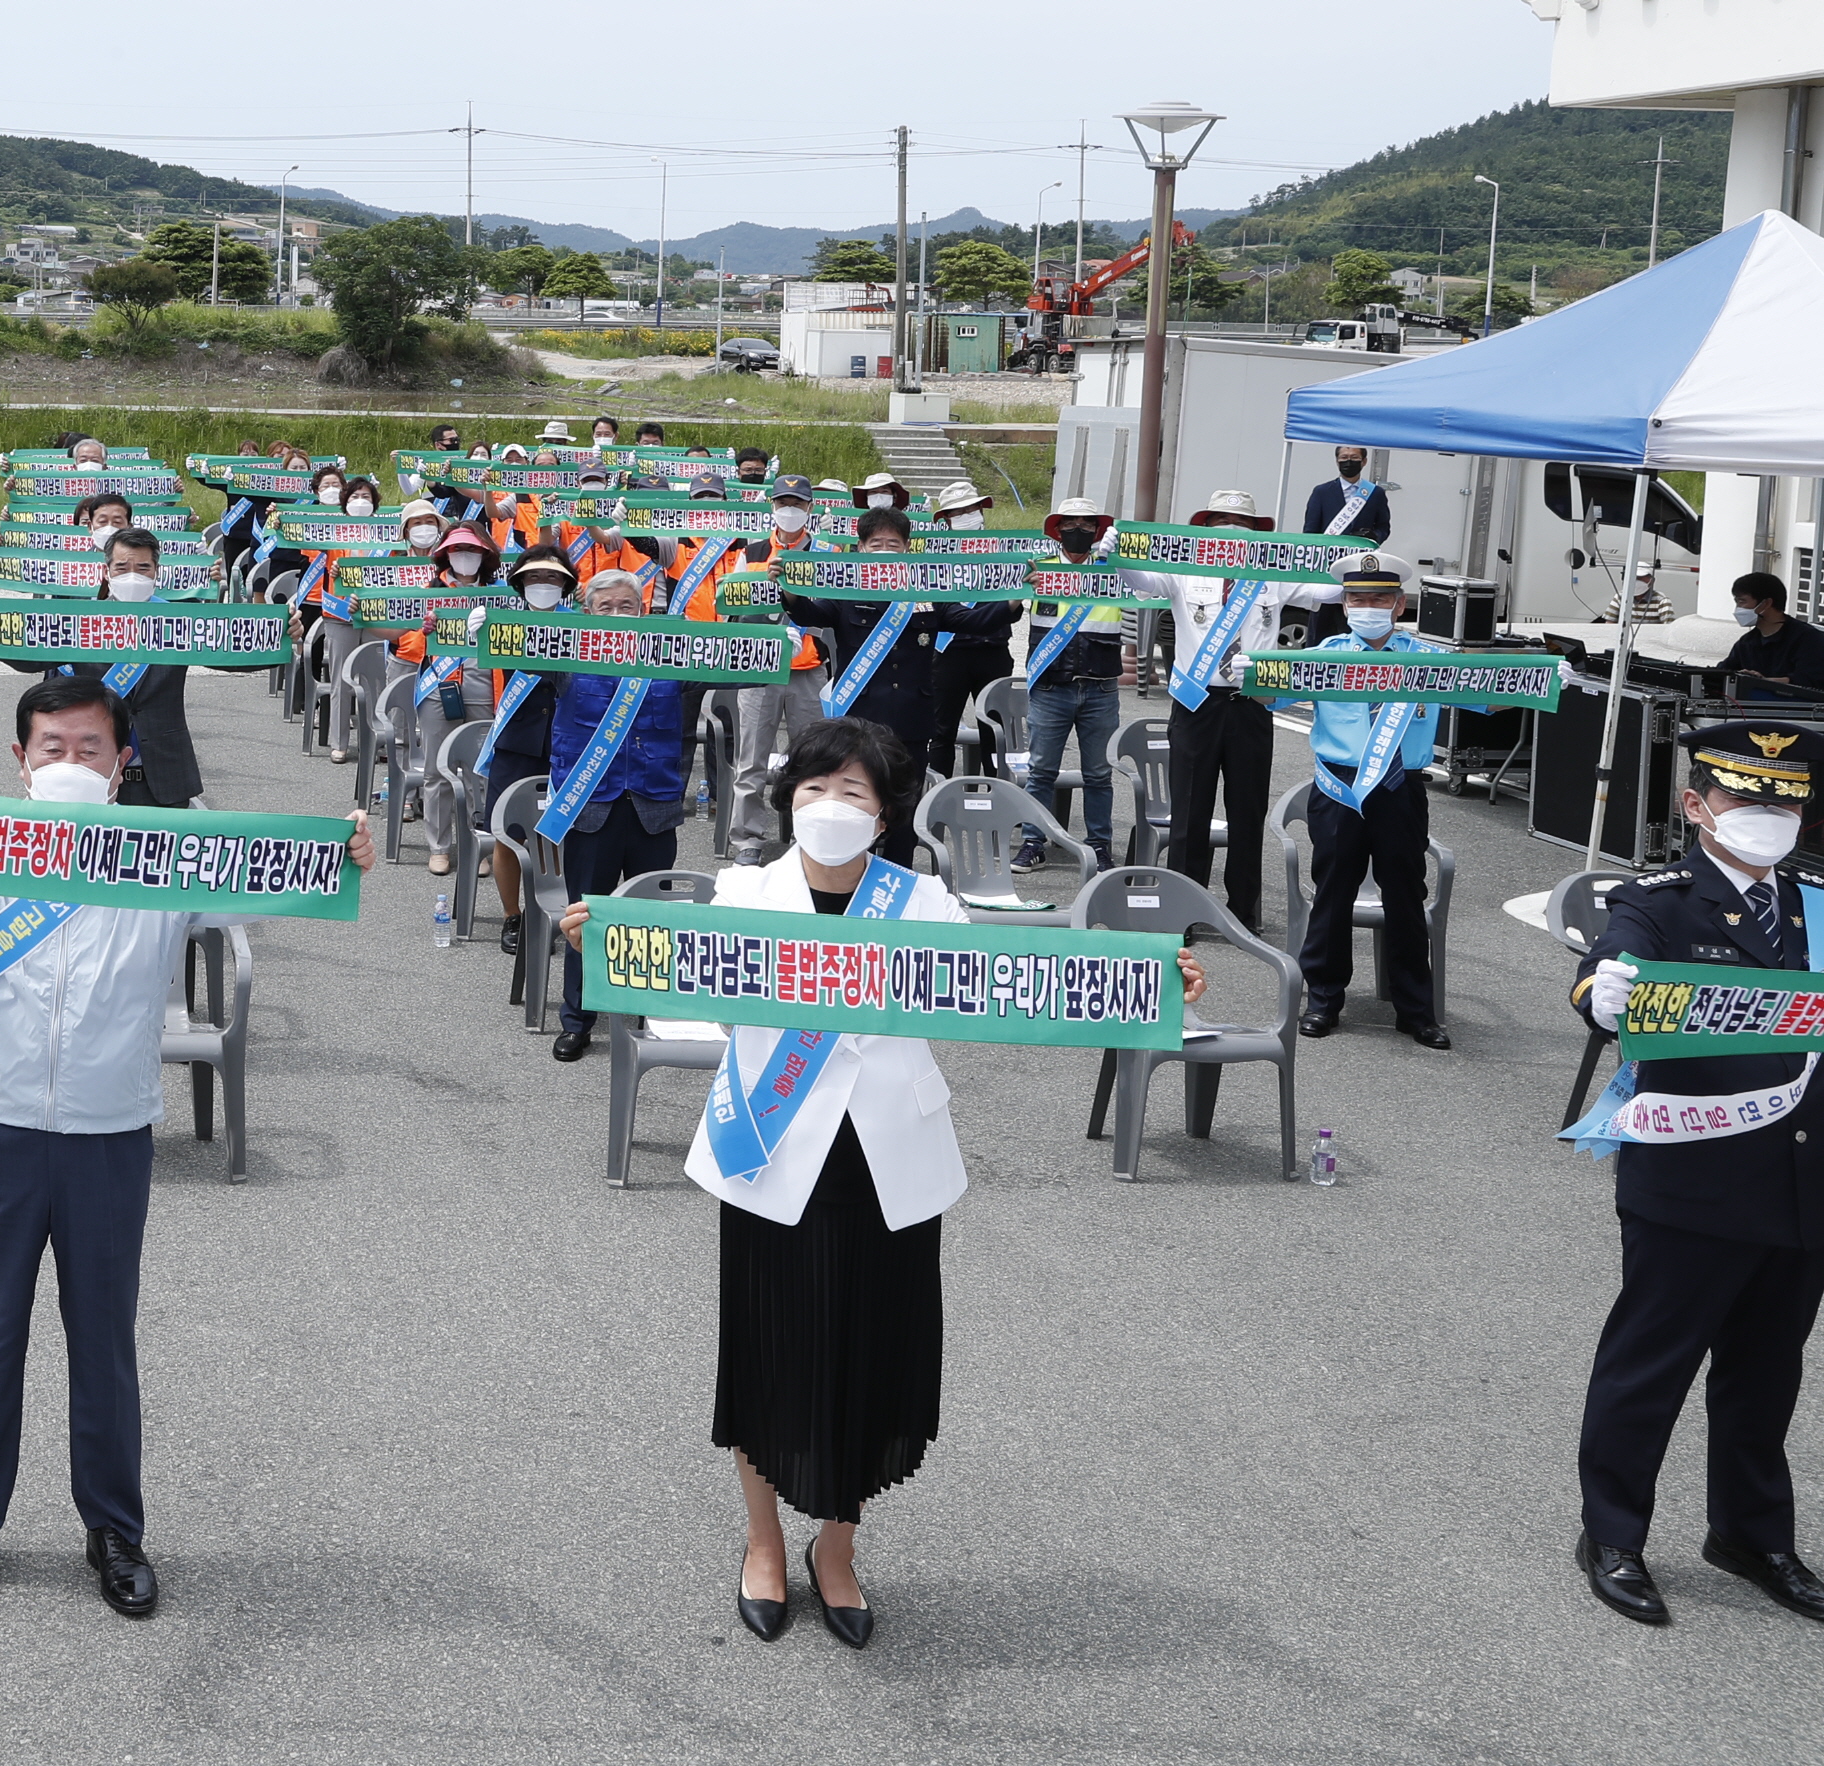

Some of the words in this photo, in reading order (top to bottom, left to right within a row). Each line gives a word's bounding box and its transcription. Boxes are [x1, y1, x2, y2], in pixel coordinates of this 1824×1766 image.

[35, 478, 63, 496] 전라남도!
[64, 478, 96, 497] 불법주정차
[97, 477, 125, 496] 이제그만!
[126, 477, 147, 496] 우리가
[275, 474, 302, 493] 불법주정차
[527, 471, 557, 488] 불법주정차
[282, 523, 303, 541] 안전한
[304, 523, 334, 542] 전라남도!
[335, 524, 369, 542] 불법주정차
[628, 509, 651, 528] 안전한
[653, 509, 686, 530] 전라남도!
[688, 510, 727, 531] 불법주정차
[728, 511, 761, 533] 이제그만!
[1119, 532, 1149, 560] 안전한
[1150, 534, 1194, 564] 전라남도!
[1196, 537, 1247, 568] 불법주정차
[1248, 540, 1292, 571] 이제그만!
[22, 558, 60, 585] 전라남도!
[362, 565, 397, 587] 전라남도!
[785, 561, 815, 587] 안전한
[816, 562, 858, 588] 전라남도!
[860, 563, 908, 591] 불법주정차
[910, 563, 951, 591] 이제그만!
[953, 563, 983, 592] 우리가
[983, 562, 1026, 590] 앞장서자!
[1221, 597, 1244, 628] 교통안전
[25, 612, 76, 647] 전라남도!
[78, 614, 138, 649] 불법주정차
[138, 616, 191, 652] 이제그만!
[192, 617, 230, 652] 우리가
[230, 617, 284, 652] 앞장서자!
[436, 619, 466, 645] 안전한
[488, 622, 524, 657] 안전한
[525, 625, 577, 660] 전라남도!
[578, 630, 637, 666] 불법주정차
[638, 632, 690, 669] 이제그만!
[692, 636, 728, 671] 우리가
[728, 637, 781, 672] 앞장서자!
[866, 627, 892, 658] 교통안전
[1205, 628, 1227, 653] 릴레이
[850, 657, 872, 681] 릴레이
[1192, 654, 1214, 679] 캠페인
[1256, 660, 1290, 689] 안전한
[1290, 662, 1342, 692] 전라남도!
[1343, 663, 1403, 693] 불법주정차
[1404, 665, 1456, 693] 이제그만!
[1457, 668, 1494, 694] 우리가
[1494, 668, 1550, 698] 앞장서자!
[834, 680, 856, 704] 캠페인
[1370, 725, 1396, 755] 릴레이
[1357, 755, 1383, 786] 캠페인
[75, 826, 176, 887] 이제그만!
[175, 834, 246, 892] 우리가
[244, 838, 344, 896] 앞장서자!
[604, 924, 672, 991] 안전한
[674, 930, 771, 998] 전라남도!
[774, 938, 888, 1010] 불법주정차
[890, 946, 988, 1015] 이제그만!
[990, 952, 1060, 1020] 우리가
[1062, 955, 1162, 1024] 앞장서자!
[1626, 981, 1693, 1034] 안전한
[1682, 985, 1790, 1035] 전라남도!
[1633, 1100, 1675, 1135] 멈춤
[1737, 1081, 1803, 1124] 보이면
[1679, 1105, 1732, 1135] 일단
